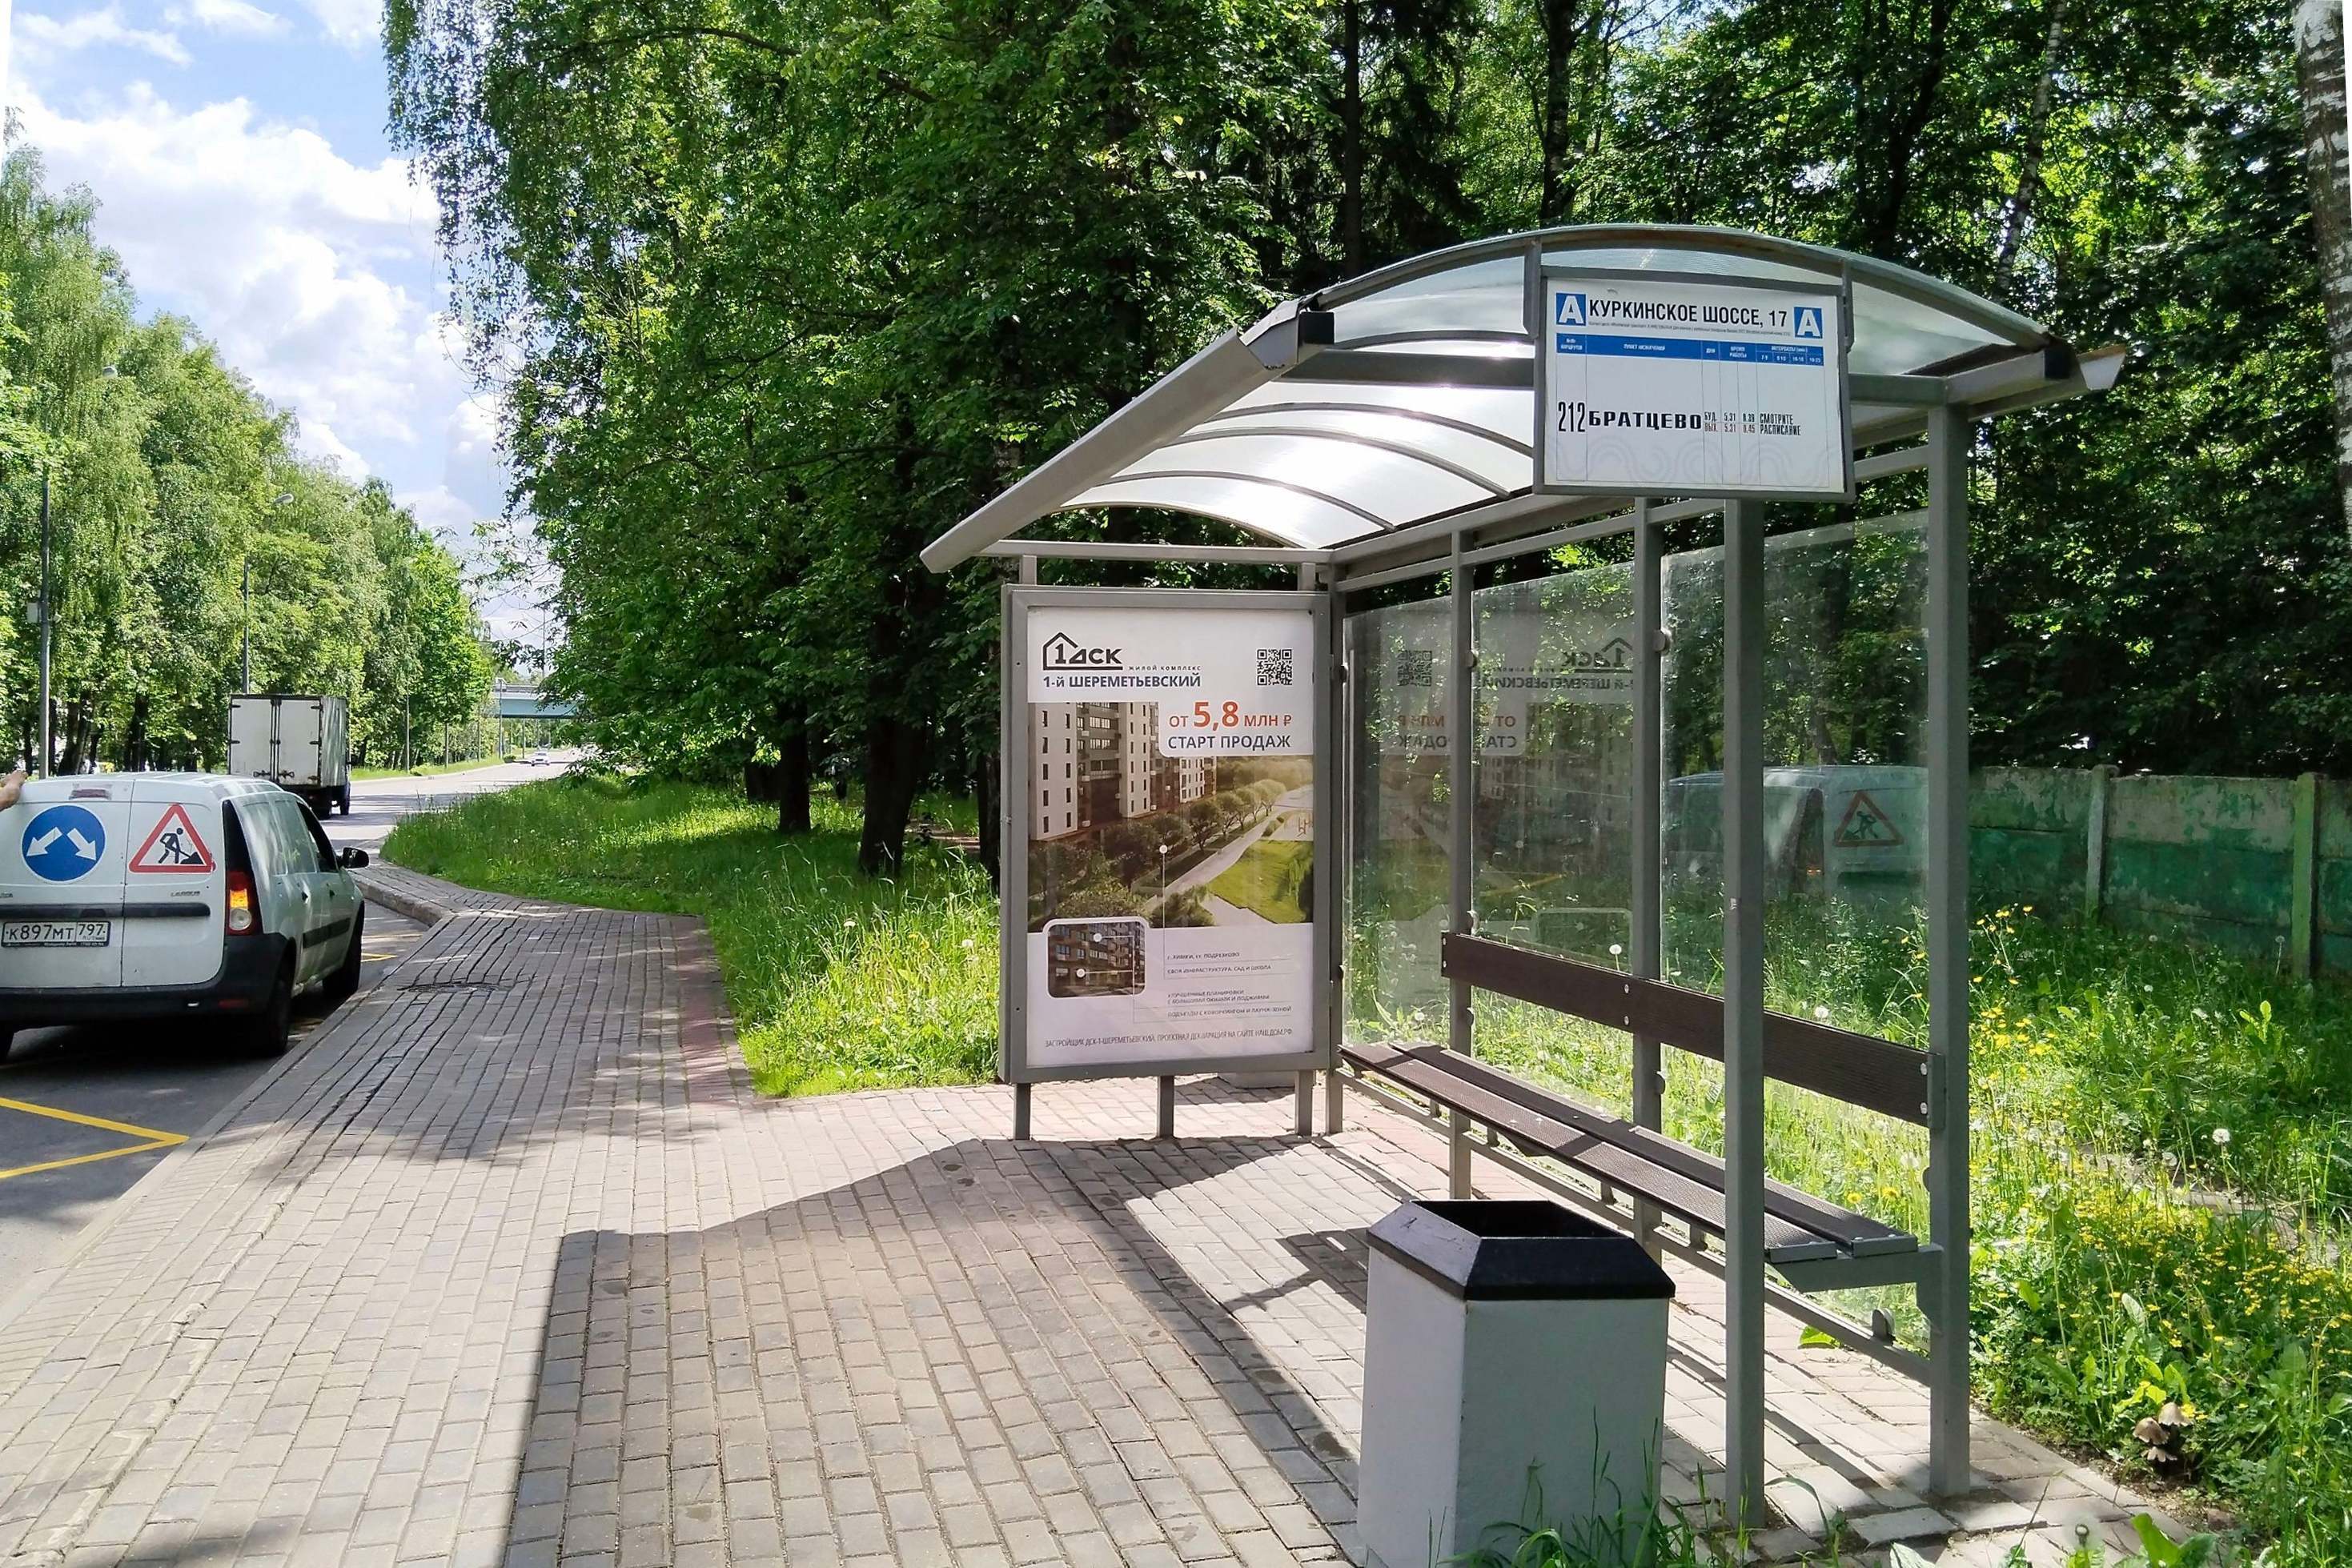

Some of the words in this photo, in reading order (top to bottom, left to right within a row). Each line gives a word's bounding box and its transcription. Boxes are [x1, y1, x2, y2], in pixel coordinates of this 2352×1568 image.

[1589, 299, 1697, 321] КУРКИНСКОЕ
[1703, 306, 1764, 328] ШОССЕ,
[1768, 311, 1788, 327] 17
[1558, 401, 1586, 432] 212
[1589, 411, 1702, 431] БРАТЦЕВО
[1760, 413, 1794, 425] СМОТРИТЕ
[1760, 423, 1801, 436] РАСПИСАНИЕ
[1069, 672, 1201, 688] ШЕРЕМЕТЬЕВСКИЙ
[1169, 716, 1189, 728] ОТ
[1194, 701, 1239, 732] 5,8
[1244, 715, 1278, 727] МЛН
[1168, 736, 1215, 749] СТАРТ
[1221, 735, 1290, 751] ПРОДАЖ
[78, 924, 104, 936] 797
